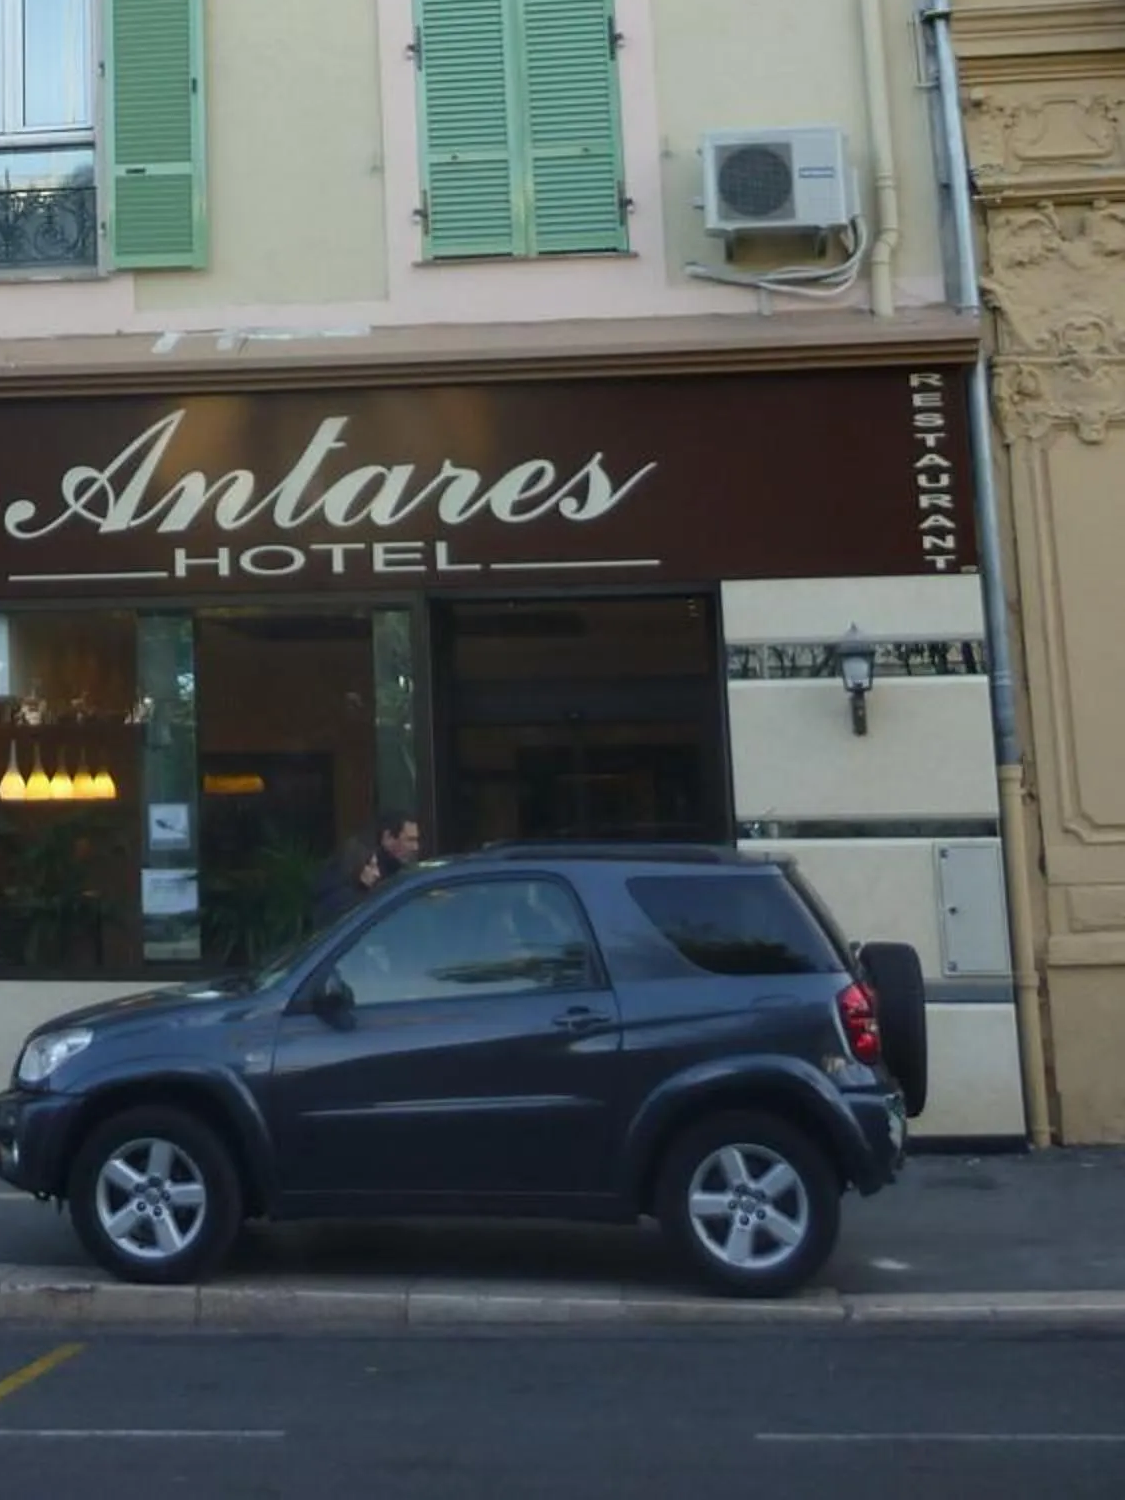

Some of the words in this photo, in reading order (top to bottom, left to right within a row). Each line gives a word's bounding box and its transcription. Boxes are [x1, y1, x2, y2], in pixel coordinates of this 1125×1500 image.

[4, 409, 657, 539] Antares
[909, 373, 956, 570] RESTAURANT
[175, 541, 482, 577] HOTEL
